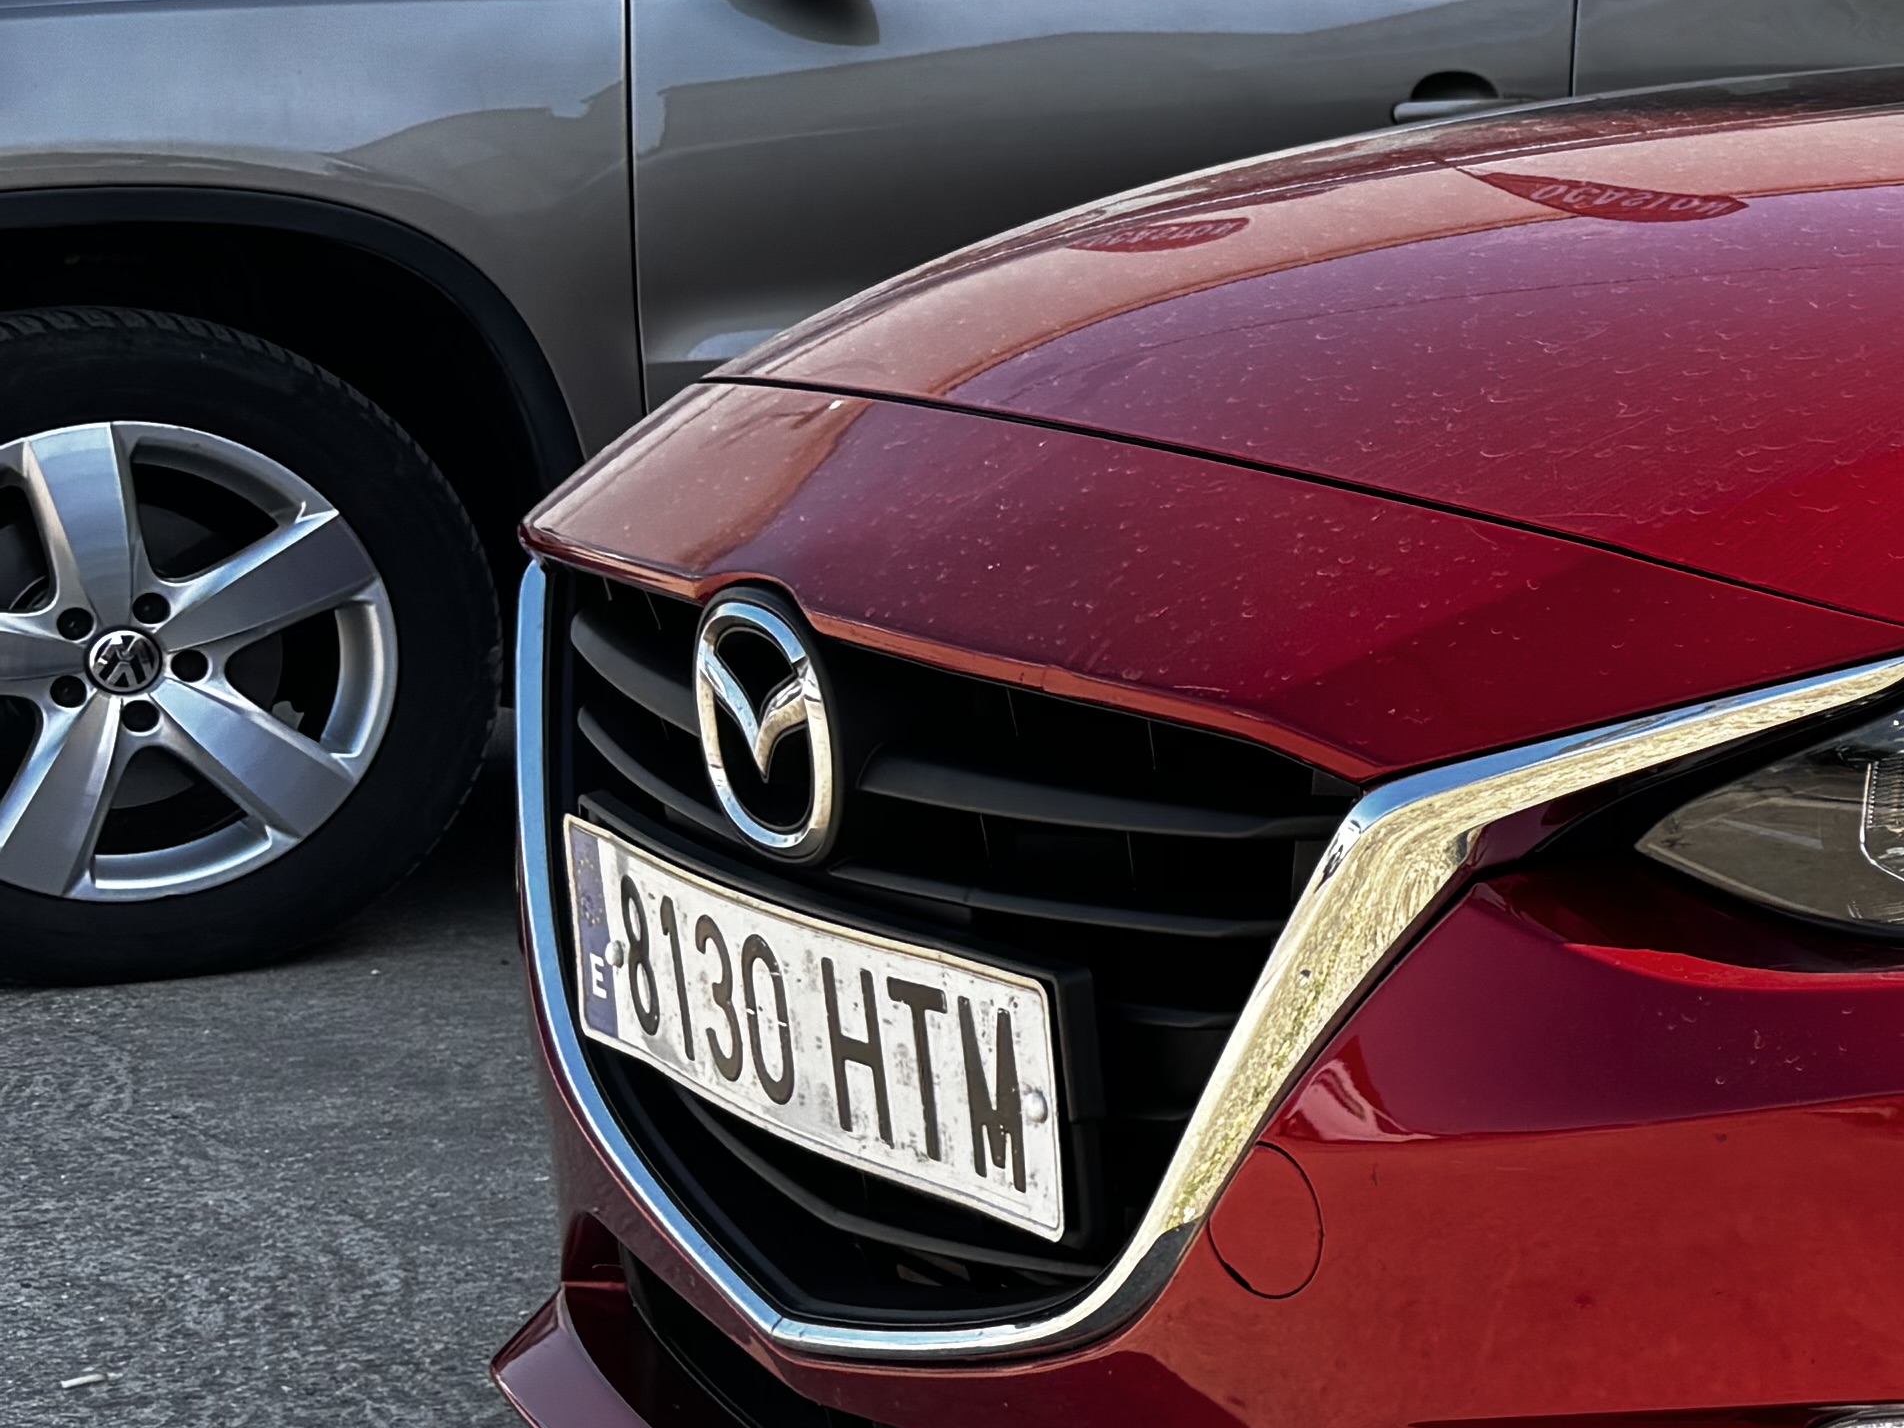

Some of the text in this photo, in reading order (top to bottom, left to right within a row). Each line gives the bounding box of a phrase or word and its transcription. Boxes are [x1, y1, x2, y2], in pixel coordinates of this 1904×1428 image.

[589, 952, 608, 999] E
[619, 874, 1027, 1194] 8130 HTM
